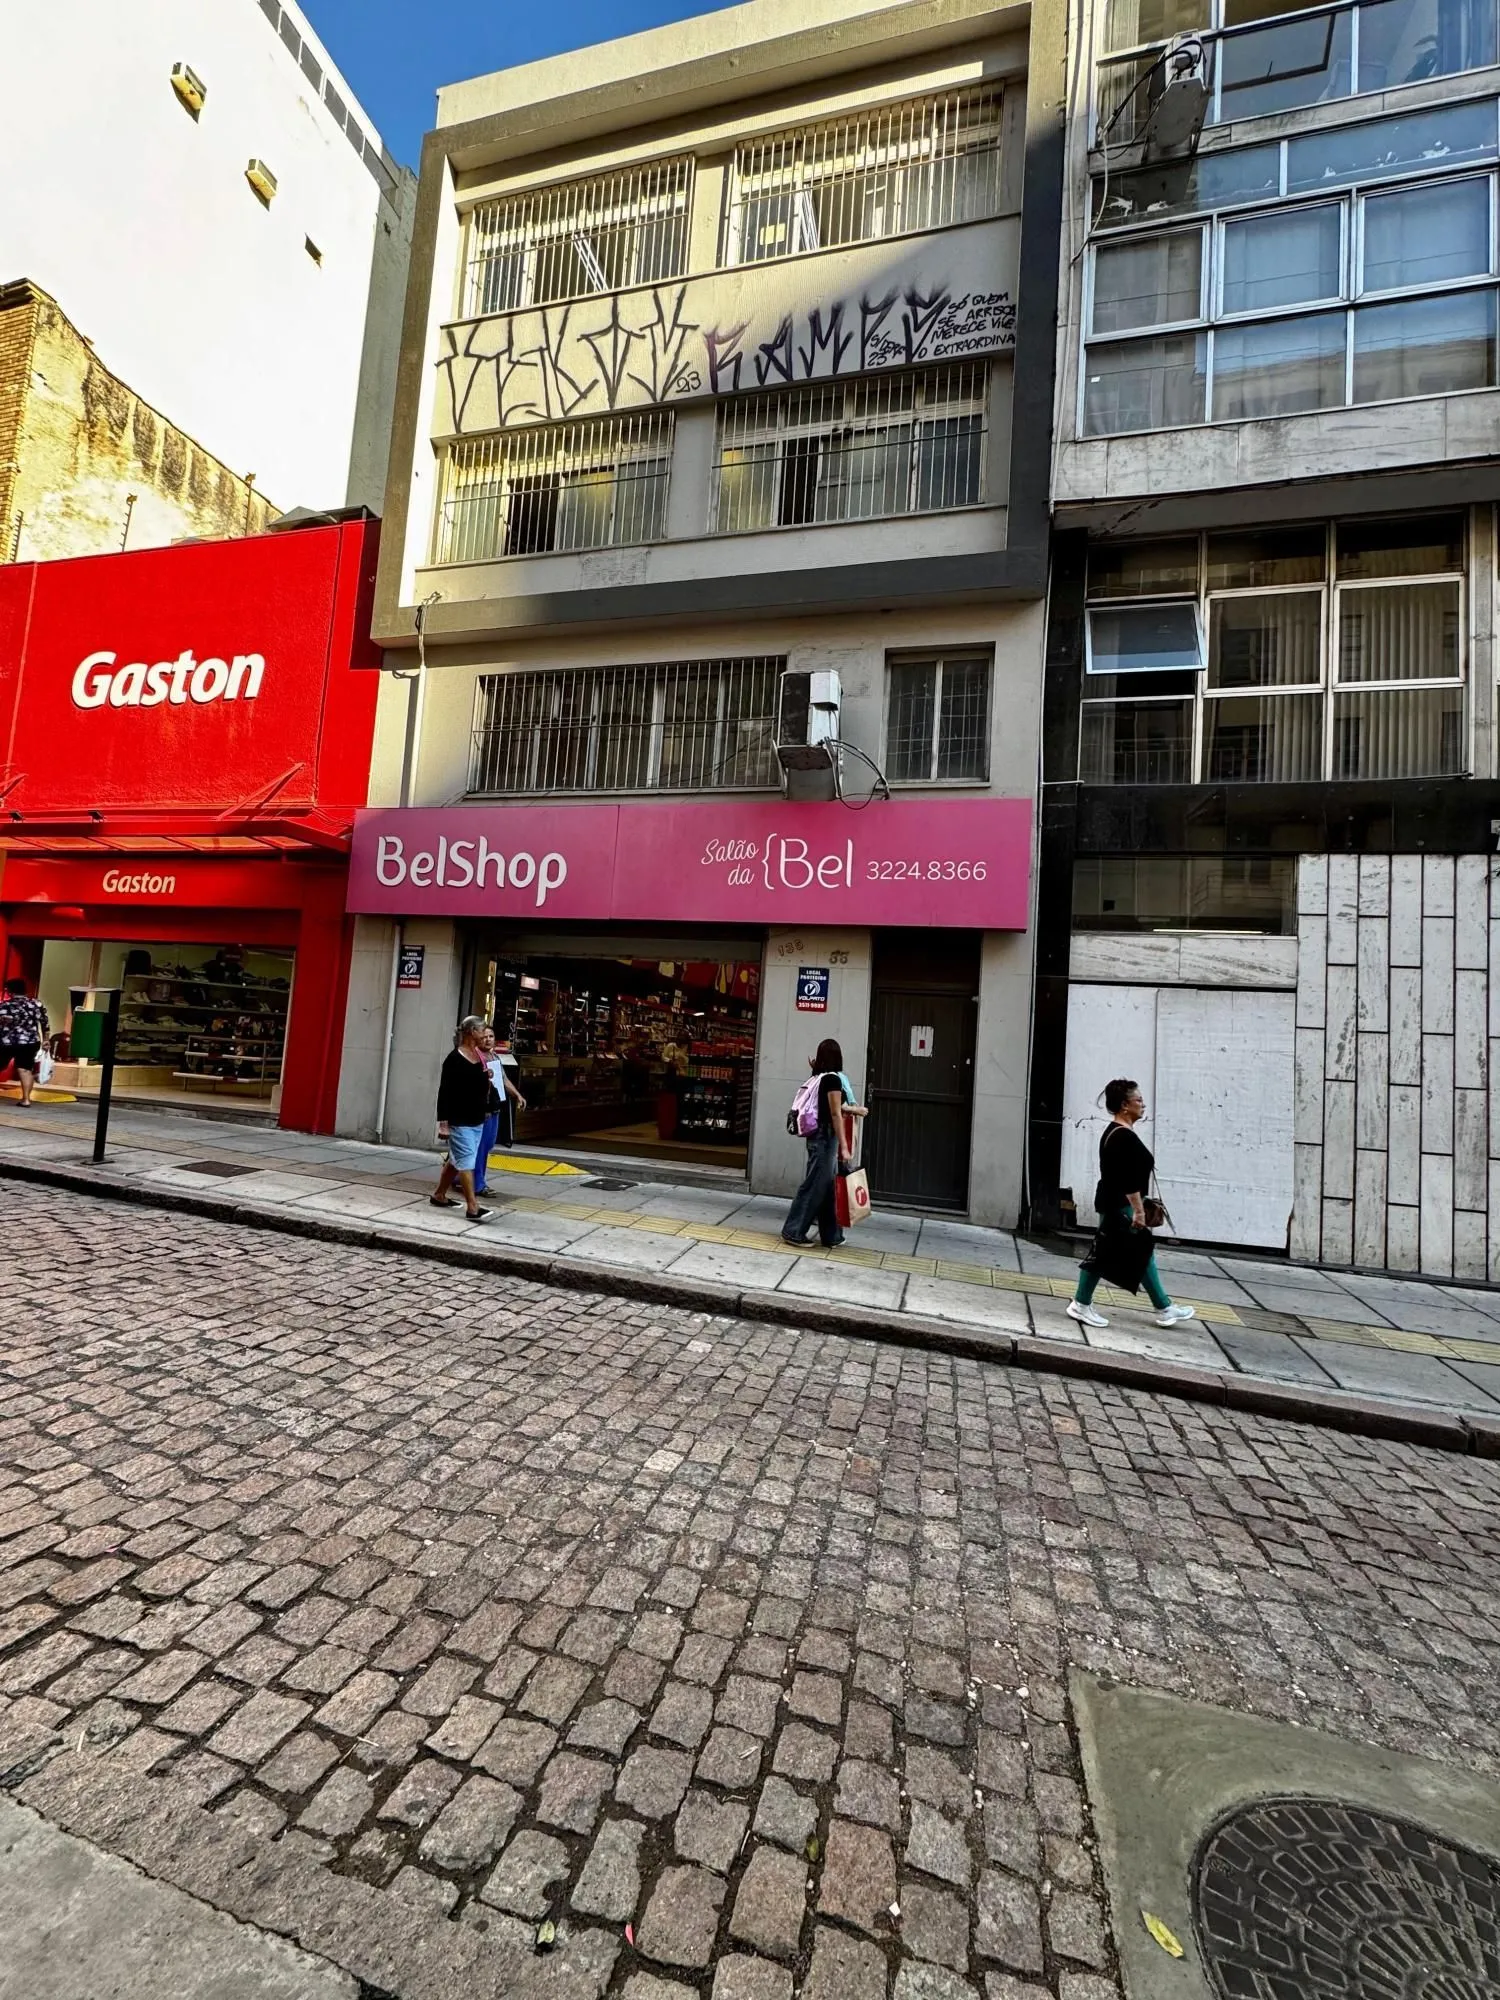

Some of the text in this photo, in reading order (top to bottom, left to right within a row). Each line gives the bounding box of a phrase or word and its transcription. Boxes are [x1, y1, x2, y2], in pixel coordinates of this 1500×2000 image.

[972, 292, 1009, 306] QUEM
[930, 319, 987, 344] MERECE
[71, 648, 266, 709] Gaston
[701, 838, 760, 865] Salão
[102, 869, 176, 894] Gaston
[376, 834, 568, 908] BelShop
[727, 863, 755, 886] da
[866, 861, 987, 881] 3224.8366
